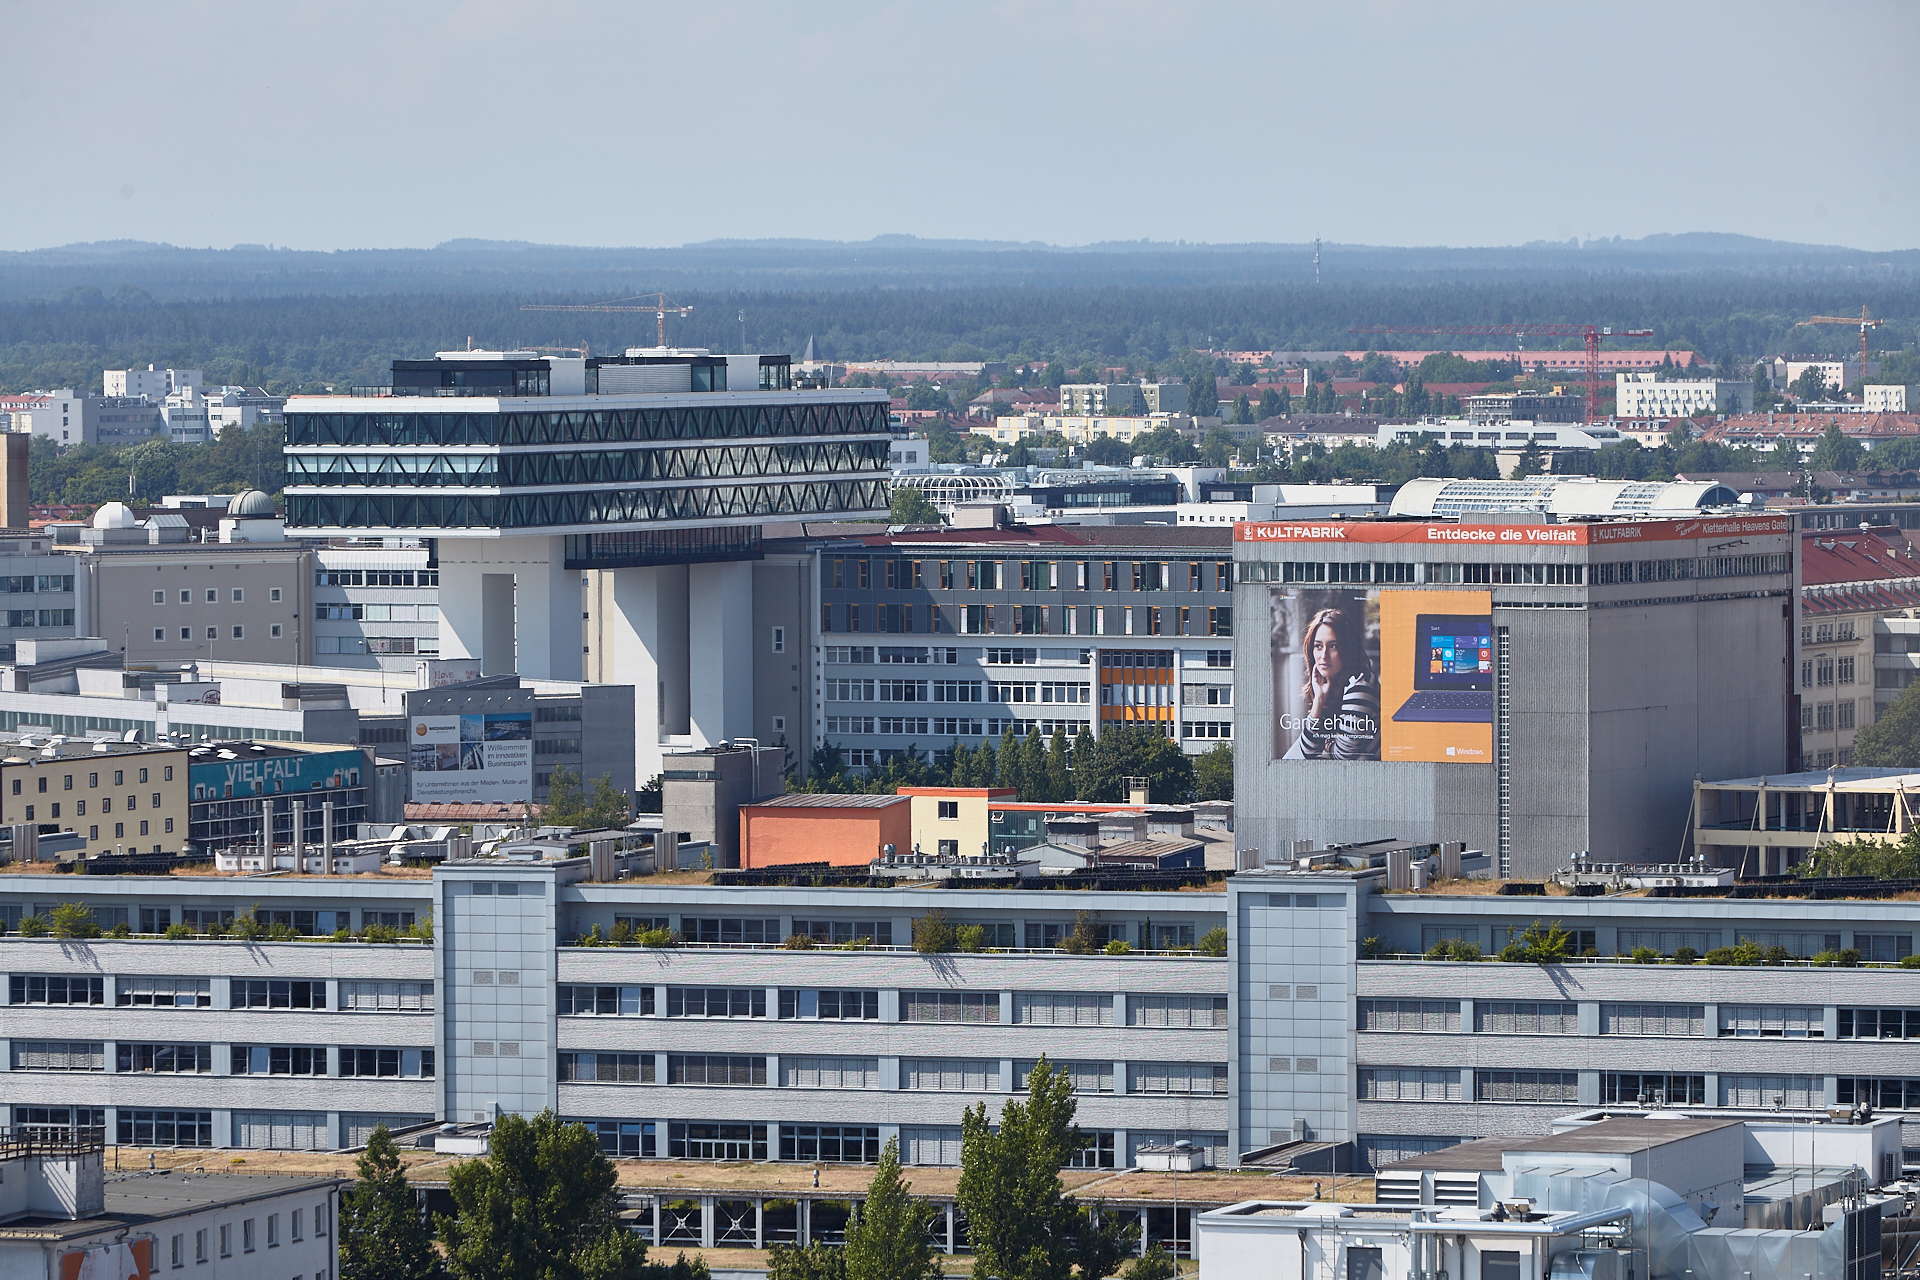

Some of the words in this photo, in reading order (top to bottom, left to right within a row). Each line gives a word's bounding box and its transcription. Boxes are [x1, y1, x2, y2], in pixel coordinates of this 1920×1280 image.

[1257, 527, 1345, 538] KULTFABRIK
[1599, 526, 1642, 540] KULTFABRIK
[1702, 522, 1740, 533] Kletterhalle
[1742, 521, 1770, 532] Heavens
[1427, 528, 1496, 540] Entdecke
[1500, 529, 1522, 540] die
[1526, 529, 1576, 541] Vielfalt
[1279, 713, 1320, 730] Ganz
[1323, 713, 1378, 734] ehrlich,
[487, 744, 528, 752] Willkommen
[226, 757, 304, 783] VIELFALT
[487, 760, 528, 768] Businesspark
